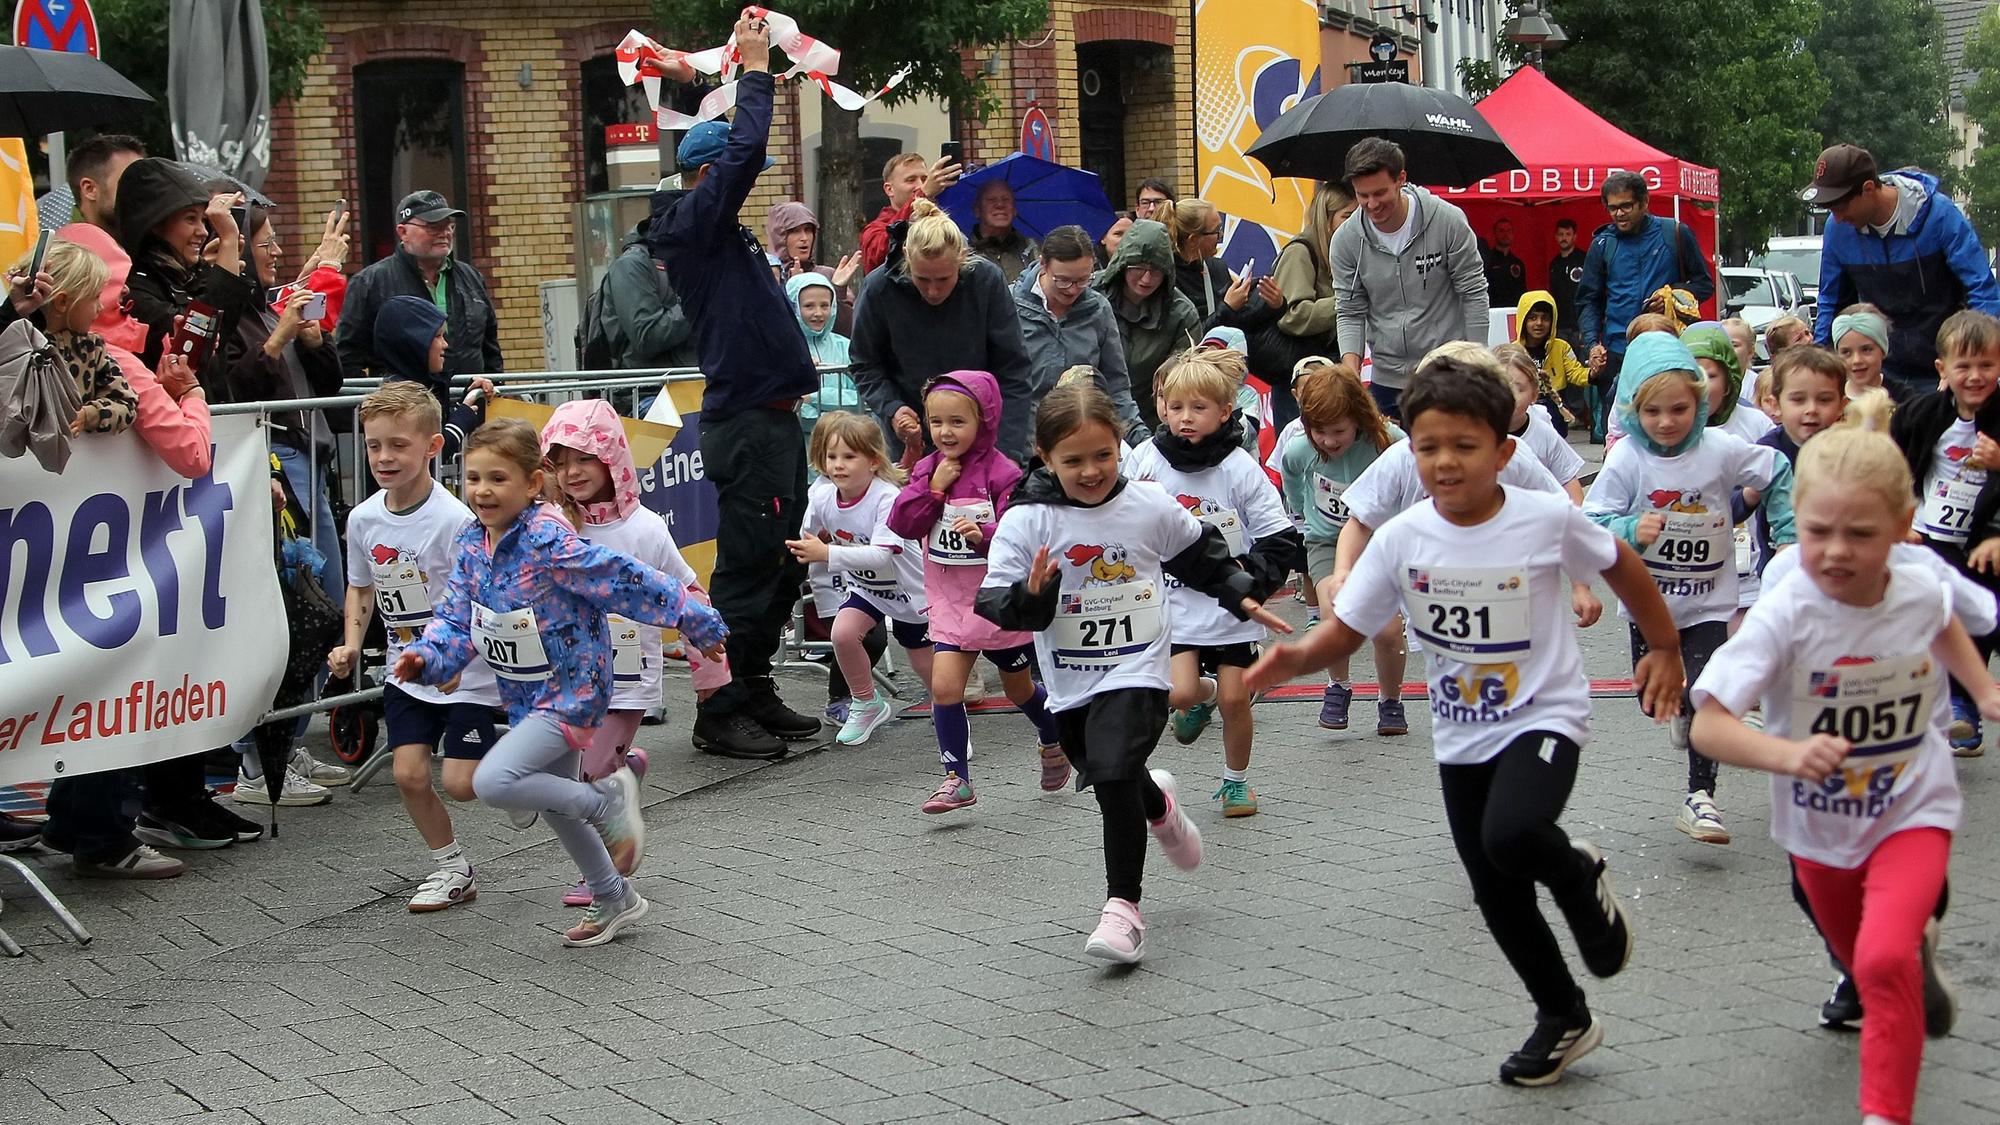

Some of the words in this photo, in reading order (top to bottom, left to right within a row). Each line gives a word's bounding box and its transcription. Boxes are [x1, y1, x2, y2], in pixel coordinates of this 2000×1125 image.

[1425, 113, 1472, 129] WAHL
[1448, 166, 1662, 193] EDBUG
[400, 208, 411, 218] 70
[1939, 505, 1974, 529] 27
[939, 529, 974, 551] 48
[1658, 538, 1710, 563] 499
[1084, 595, 1125, 607] GVG-Citylauf
[1085, 604, 1112, 613] Bedburg
[1079, 614, 1134, 648] 271
[1428, 603, 1491, 640] 231
[484, 636, 518, 664] 207
[1440, 674, 1508, 706] GVG
[41, 673, 226, 745] Laufladen
[1811, 692, 1922, 743] 4057
